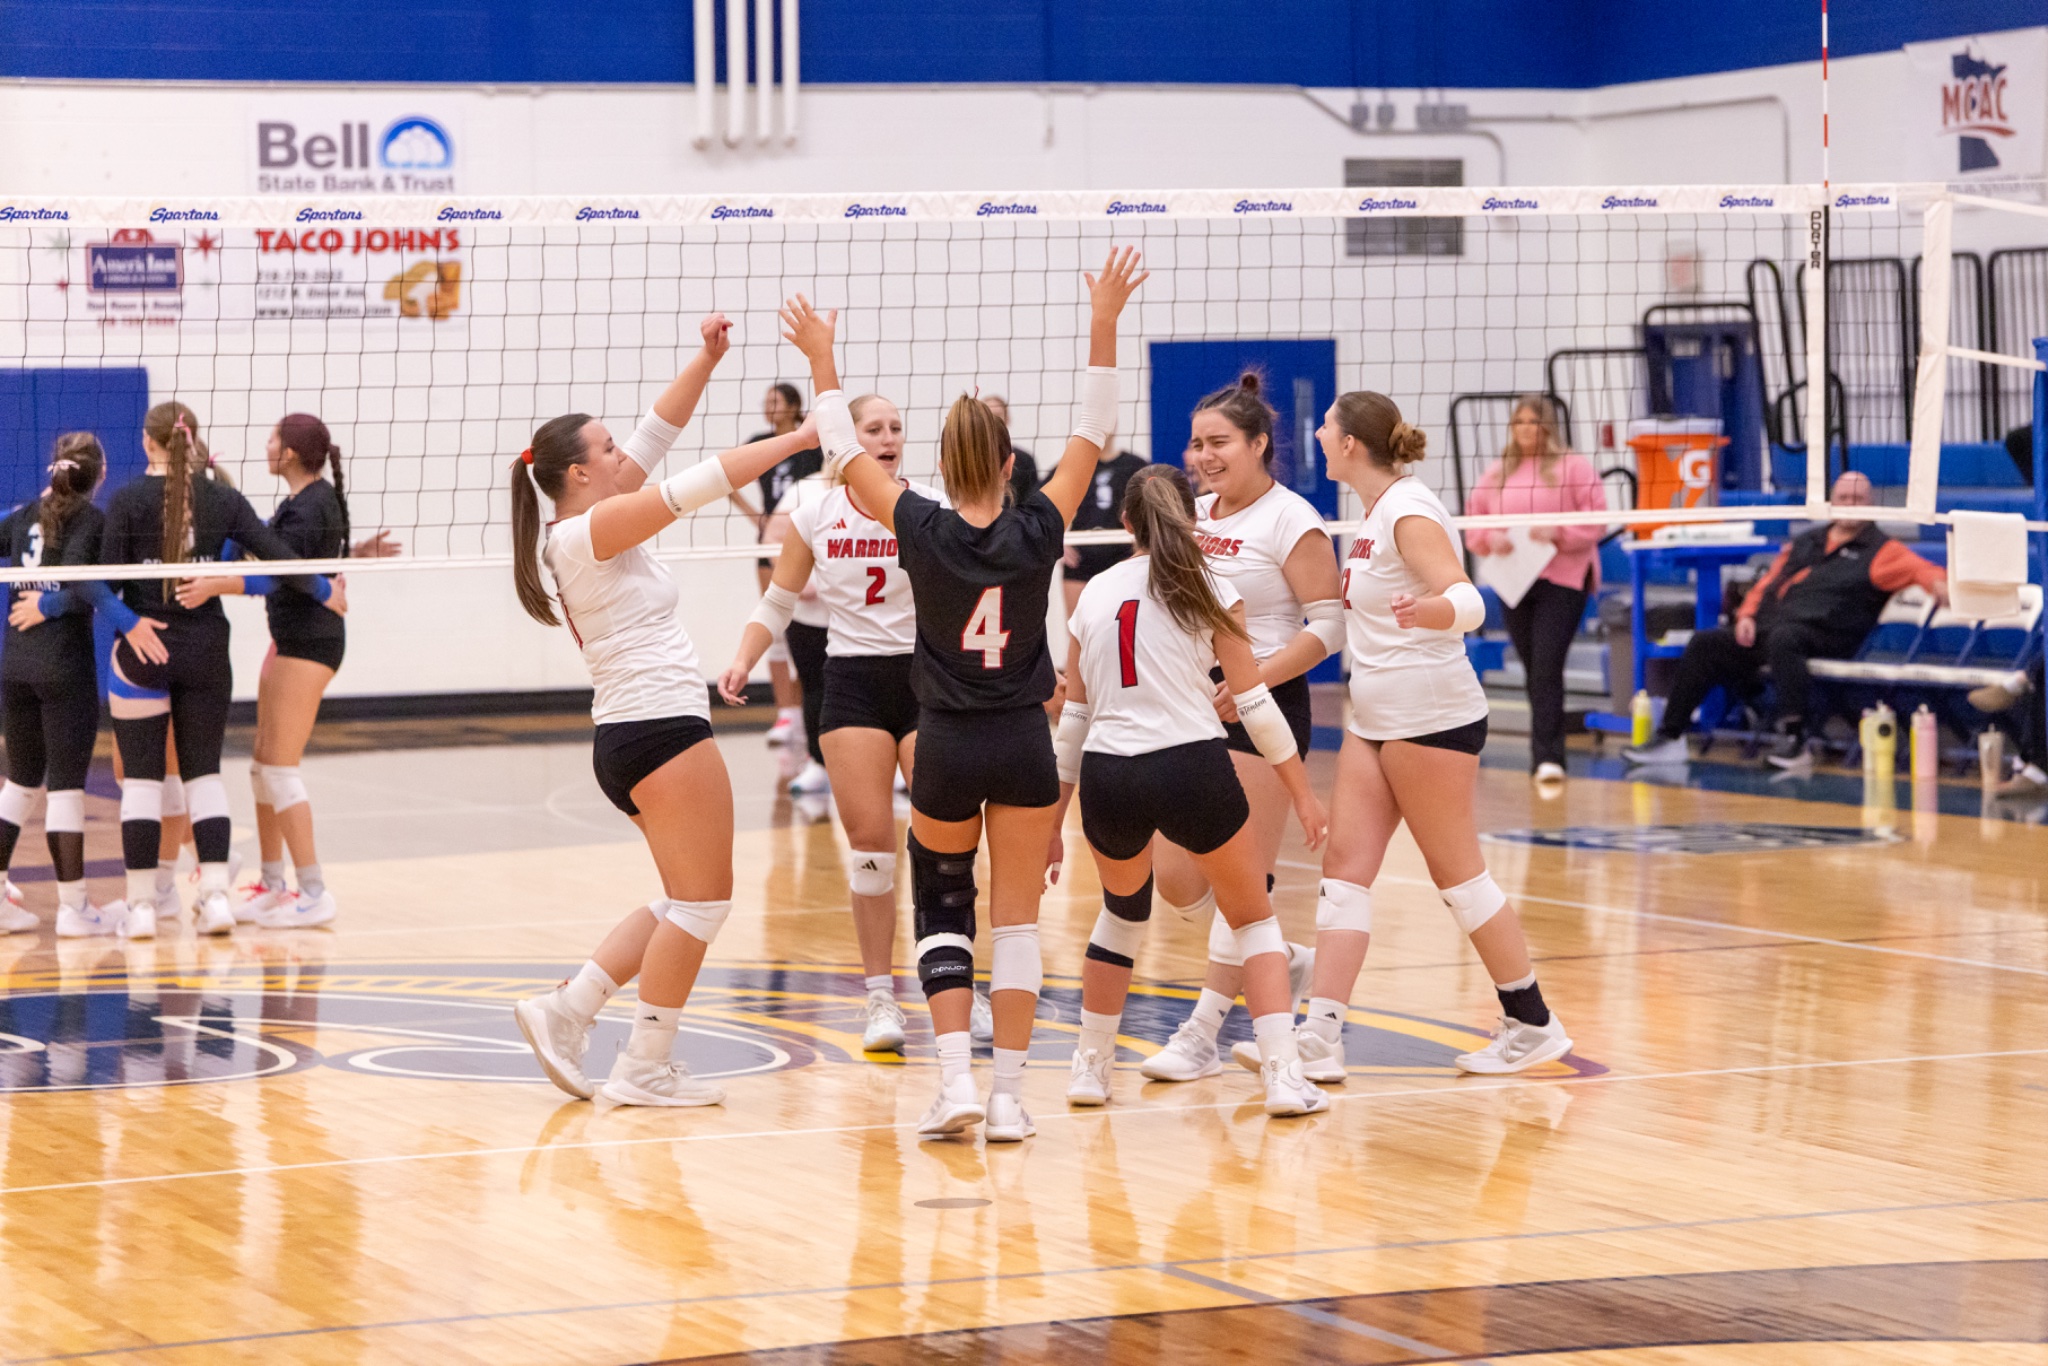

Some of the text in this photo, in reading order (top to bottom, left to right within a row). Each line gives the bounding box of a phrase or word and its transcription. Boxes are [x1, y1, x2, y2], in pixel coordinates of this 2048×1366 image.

[1942, 77, 2008, 126] MCAC
[257, 121, 370, 170] Bell
[258, 174, 455, 193] State Bank & Trust
[1106, 201, 1168, 215] Spartans
[1233, 199, 1294, 213] Spartans
[1358, 198, 1418, 211] Spartans
[1482, 197, 1540, 210] Spartans
[1601, 196, 1659, 209] Spartans
[1719, 195, 1775, 208] Spartans
[1834, 194, 1891, 207] Spartans
[0, 207, 71, 223] Spartans
[150, 207, 220, 224] Spartans
[295, 207, 364, 223] Spartans
[437, 207, 504, 222] Spartans
[575, 206, 640, 220] Spartans
[711, 205, 775, 219] Spartans
[844, 203, 908, 218] Spartans
[976, 202, 1038, 216] Spartans
[255, 228, 461, 255] TACO JOHN'S
[1679, 450, 1710, 489] G
[21, 522, 45, 568] 3
[865, 566, 887, 606] 2
[960, 584, 1012, 669] 4
[1115, 599, 1141, 689] 1
[931, 965, 969, 974] DONJOY
